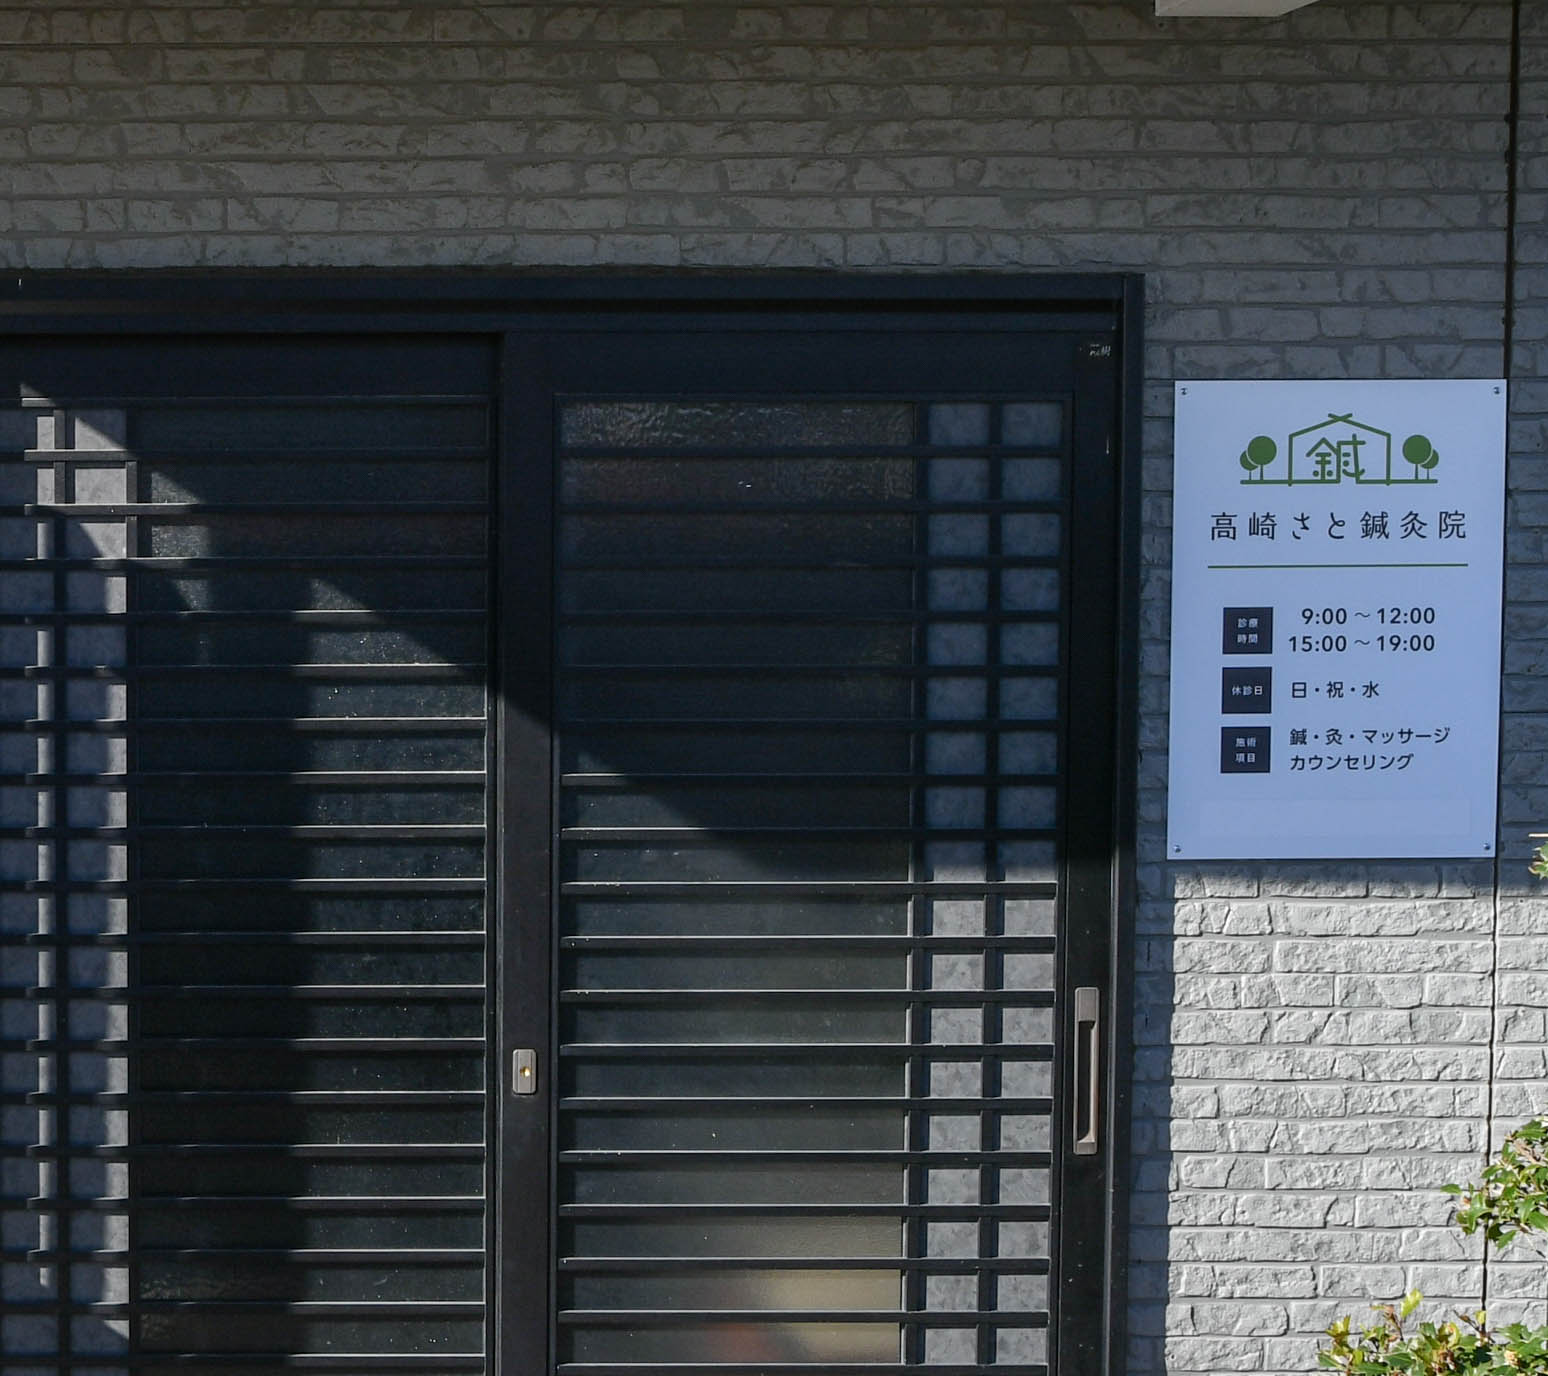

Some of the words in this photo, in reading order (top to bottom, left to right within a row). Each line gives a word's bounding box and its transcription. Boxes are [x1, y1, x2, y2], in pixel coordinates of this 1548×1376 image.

[1210, 510, 1467, 541] 高崎さと鍼灸院
[1231, 685, 1263, 696] 休診日
[1289, 727, 1451, 746] 鍼・灸・マッサージ
[1290, 753, 1414, 771] カウンセリング
